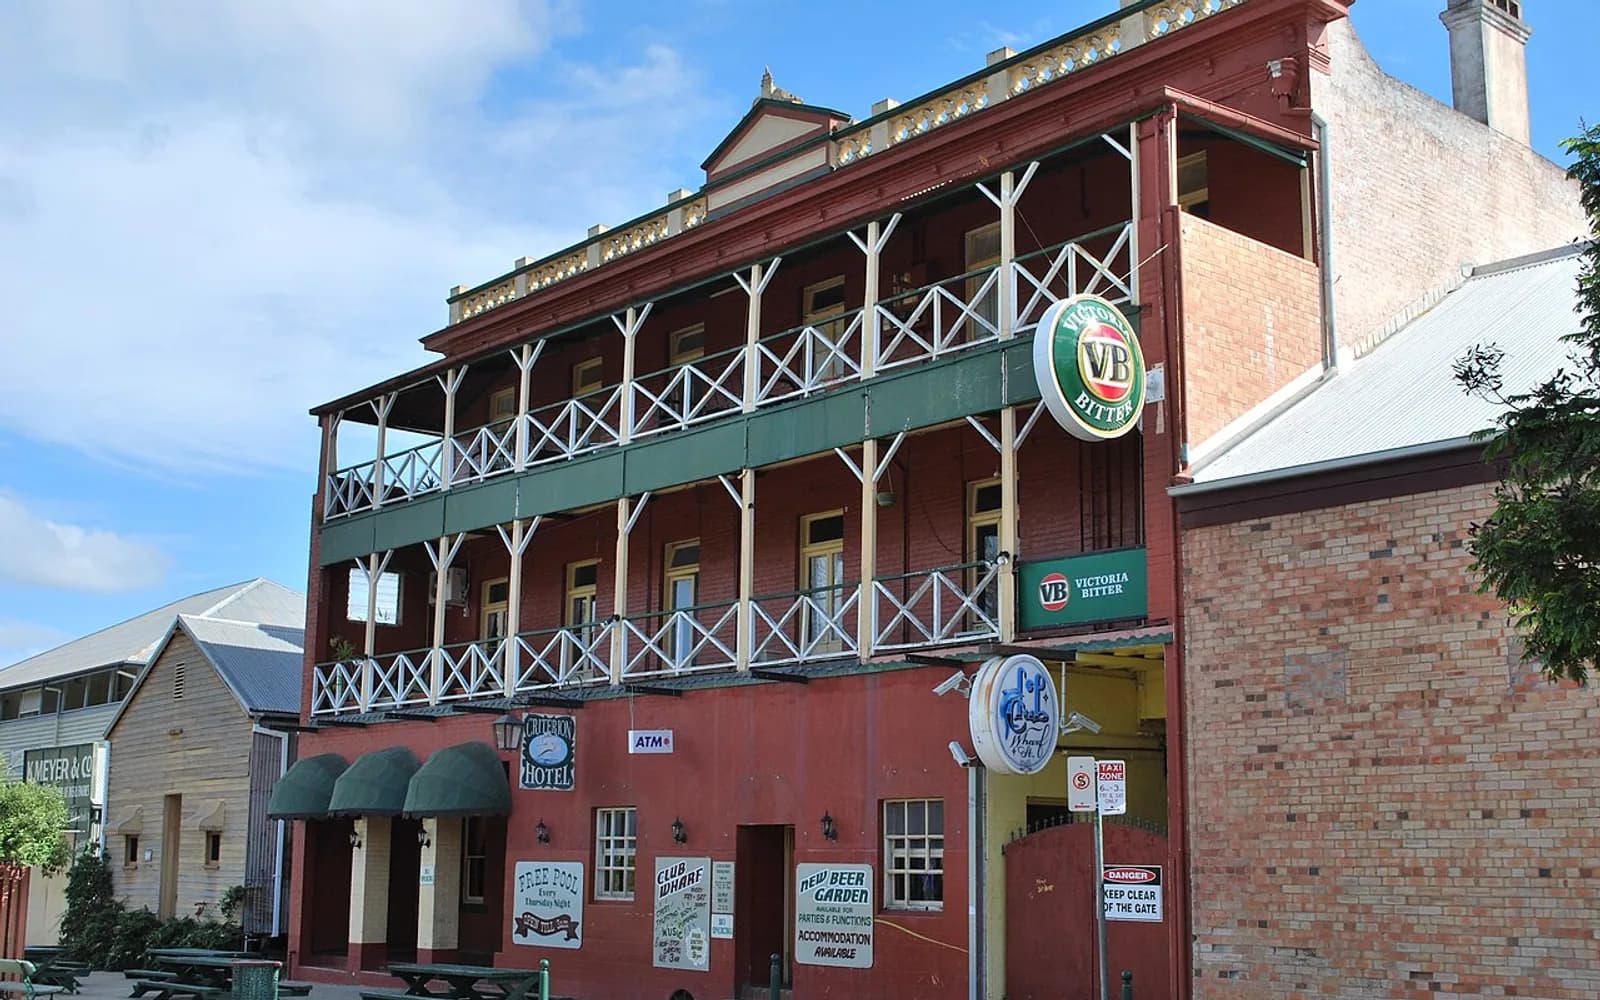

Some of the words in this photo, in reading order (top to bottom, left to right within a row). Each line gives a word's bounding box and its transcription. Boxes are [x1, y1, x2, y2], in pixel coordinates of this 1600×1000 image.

[1082, 342, 1130, 382] VB
[1074, 391, 1133, 422] BITTER
[1075, 572, 1128, 588] VICTORIA
[1040, 581, 1067, 602] VB
[1081, 584, 1123, 598] BITTER
[526, 717, 573, 739] CRITERION
[635, 736, 662, 747] ATM
[1010, 724, 1049, 759] Wharf
[71, 756, 80, 779] &
[524, 763, 570, 785] HOTEL
[1101, 764, 1122, 772] TAXI
[1100, 772, 1123, 780] ZONE
[657, 862, 686, 884] CLUB
[829, 872, 865, 885] BEER
[1108, 871, 1148, 879] DANGER
[519, 868, 549, 893] FREE
[553, 868, 578, 895] POOL
[659, 868, 703, 898] WHARF
[538, 888, 556, 898] Every
[814, 888, 868, 903] GARDEN
[1104, 889, 1125, 899] KEEP
[1127, 890, 1156, 900] CLEAR
[525, 897, 553, 908] Thursday
[553, 899, 571, 909] Night
[1104, 903, 1114, 912] OF
[1116, 903, 1132, 913] THE
[1135, 903, 1157, 914] GATE
[799, 914, 825, 924] PARTIES
[832, 915, 871, 927] FUNCTIONS
[798, 930, 871, 946] ACCOMMODATION
[814, 946, 856, 959] AVAILABLE
